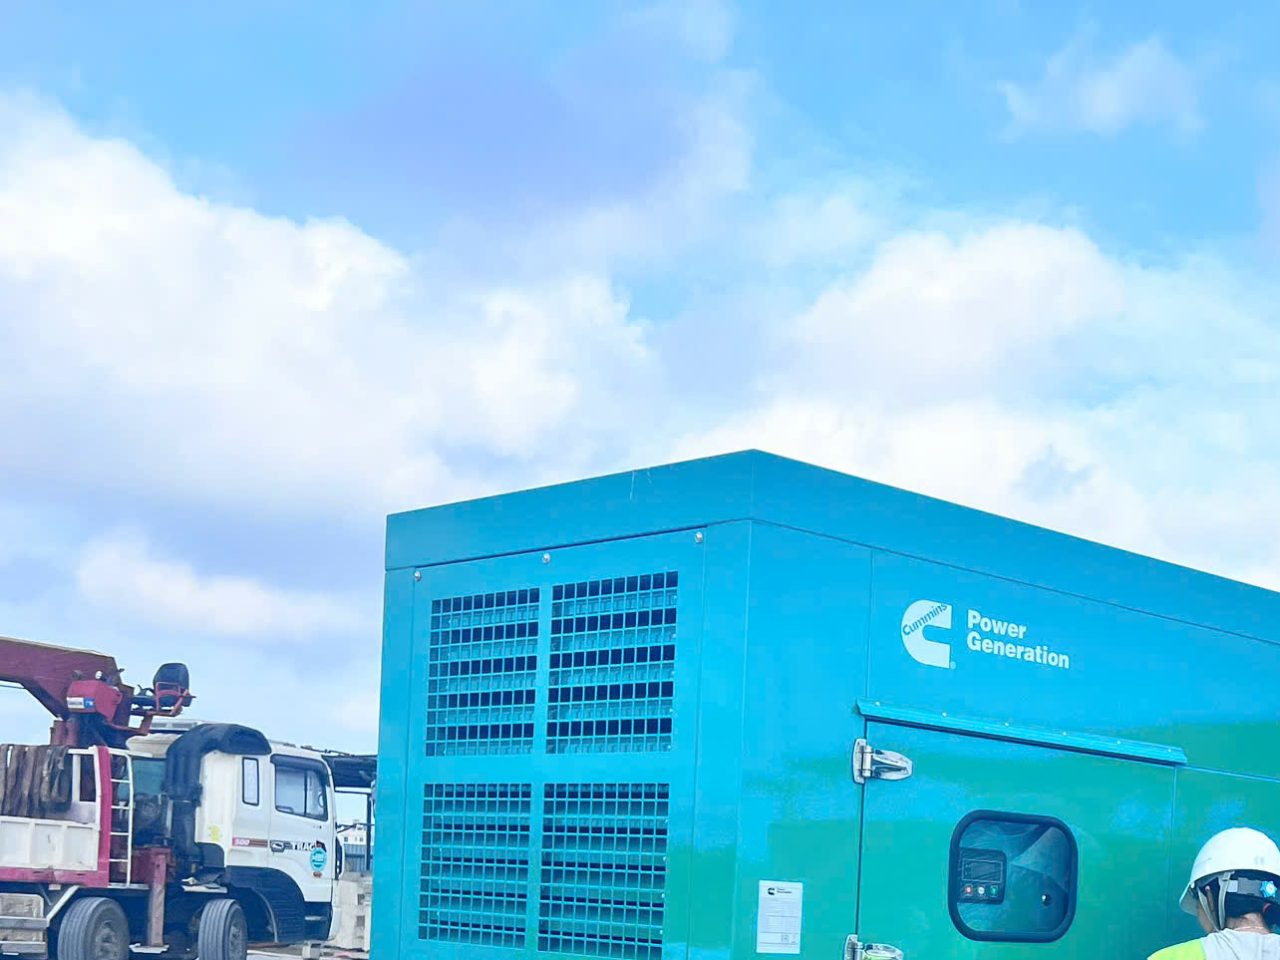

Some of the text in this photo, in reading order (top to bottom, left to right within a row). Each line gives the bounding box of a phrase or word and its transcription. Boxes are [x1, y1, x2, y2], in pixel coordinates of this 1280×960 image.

[902, 603, 948, 636] Cummins
[967, 608, 1027, 639] Power
[966, 631, 1070, 669] Generation
